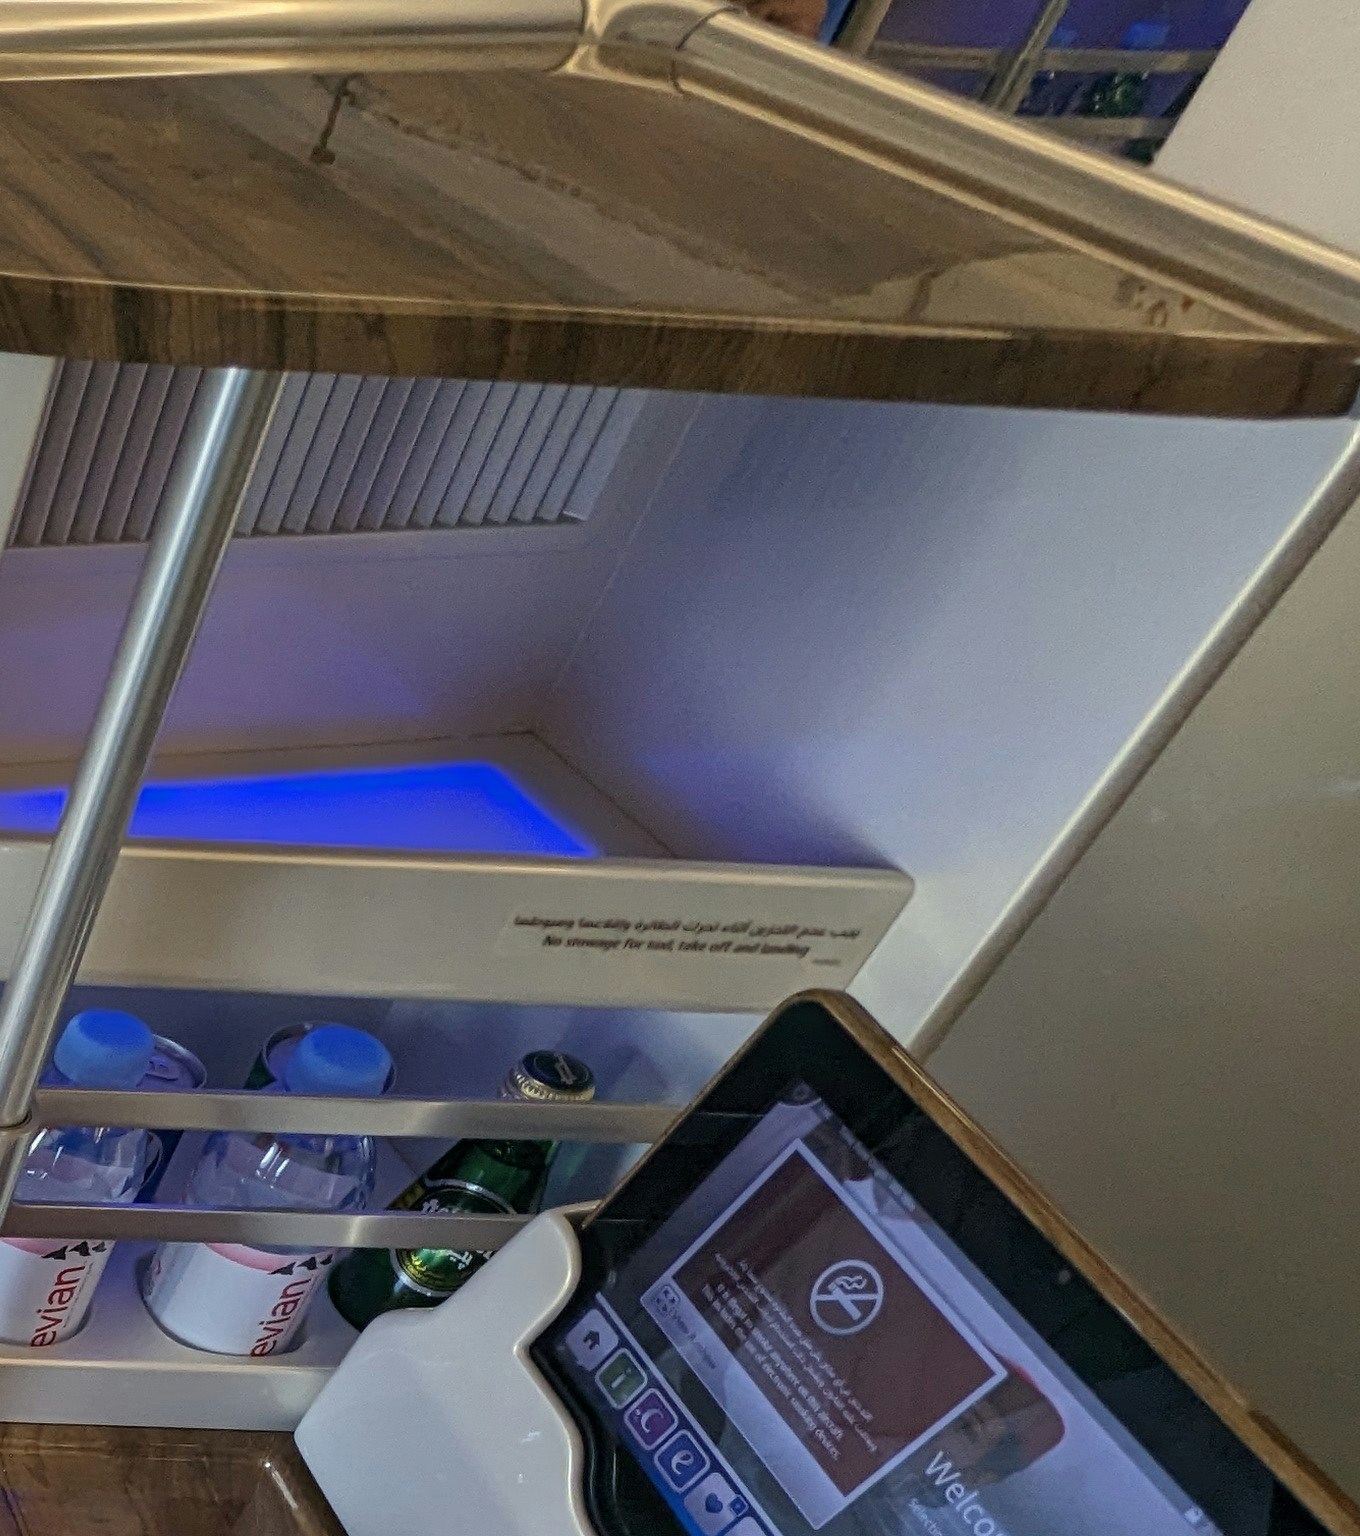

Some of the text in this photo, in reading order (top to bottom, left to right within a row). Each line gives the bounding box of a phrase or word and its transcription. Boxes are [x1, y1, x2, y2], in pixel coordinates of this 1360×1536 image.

[542, 935, 562, 947] No
[624, 938, 643, 949] for
[679, 939, 706, 951] take
[710, 941, 733, 952] off
[733, 943, 760, 952] and
[30, 1264, 86, 1348] evian
[251, 1278, 312, 1357] evian
